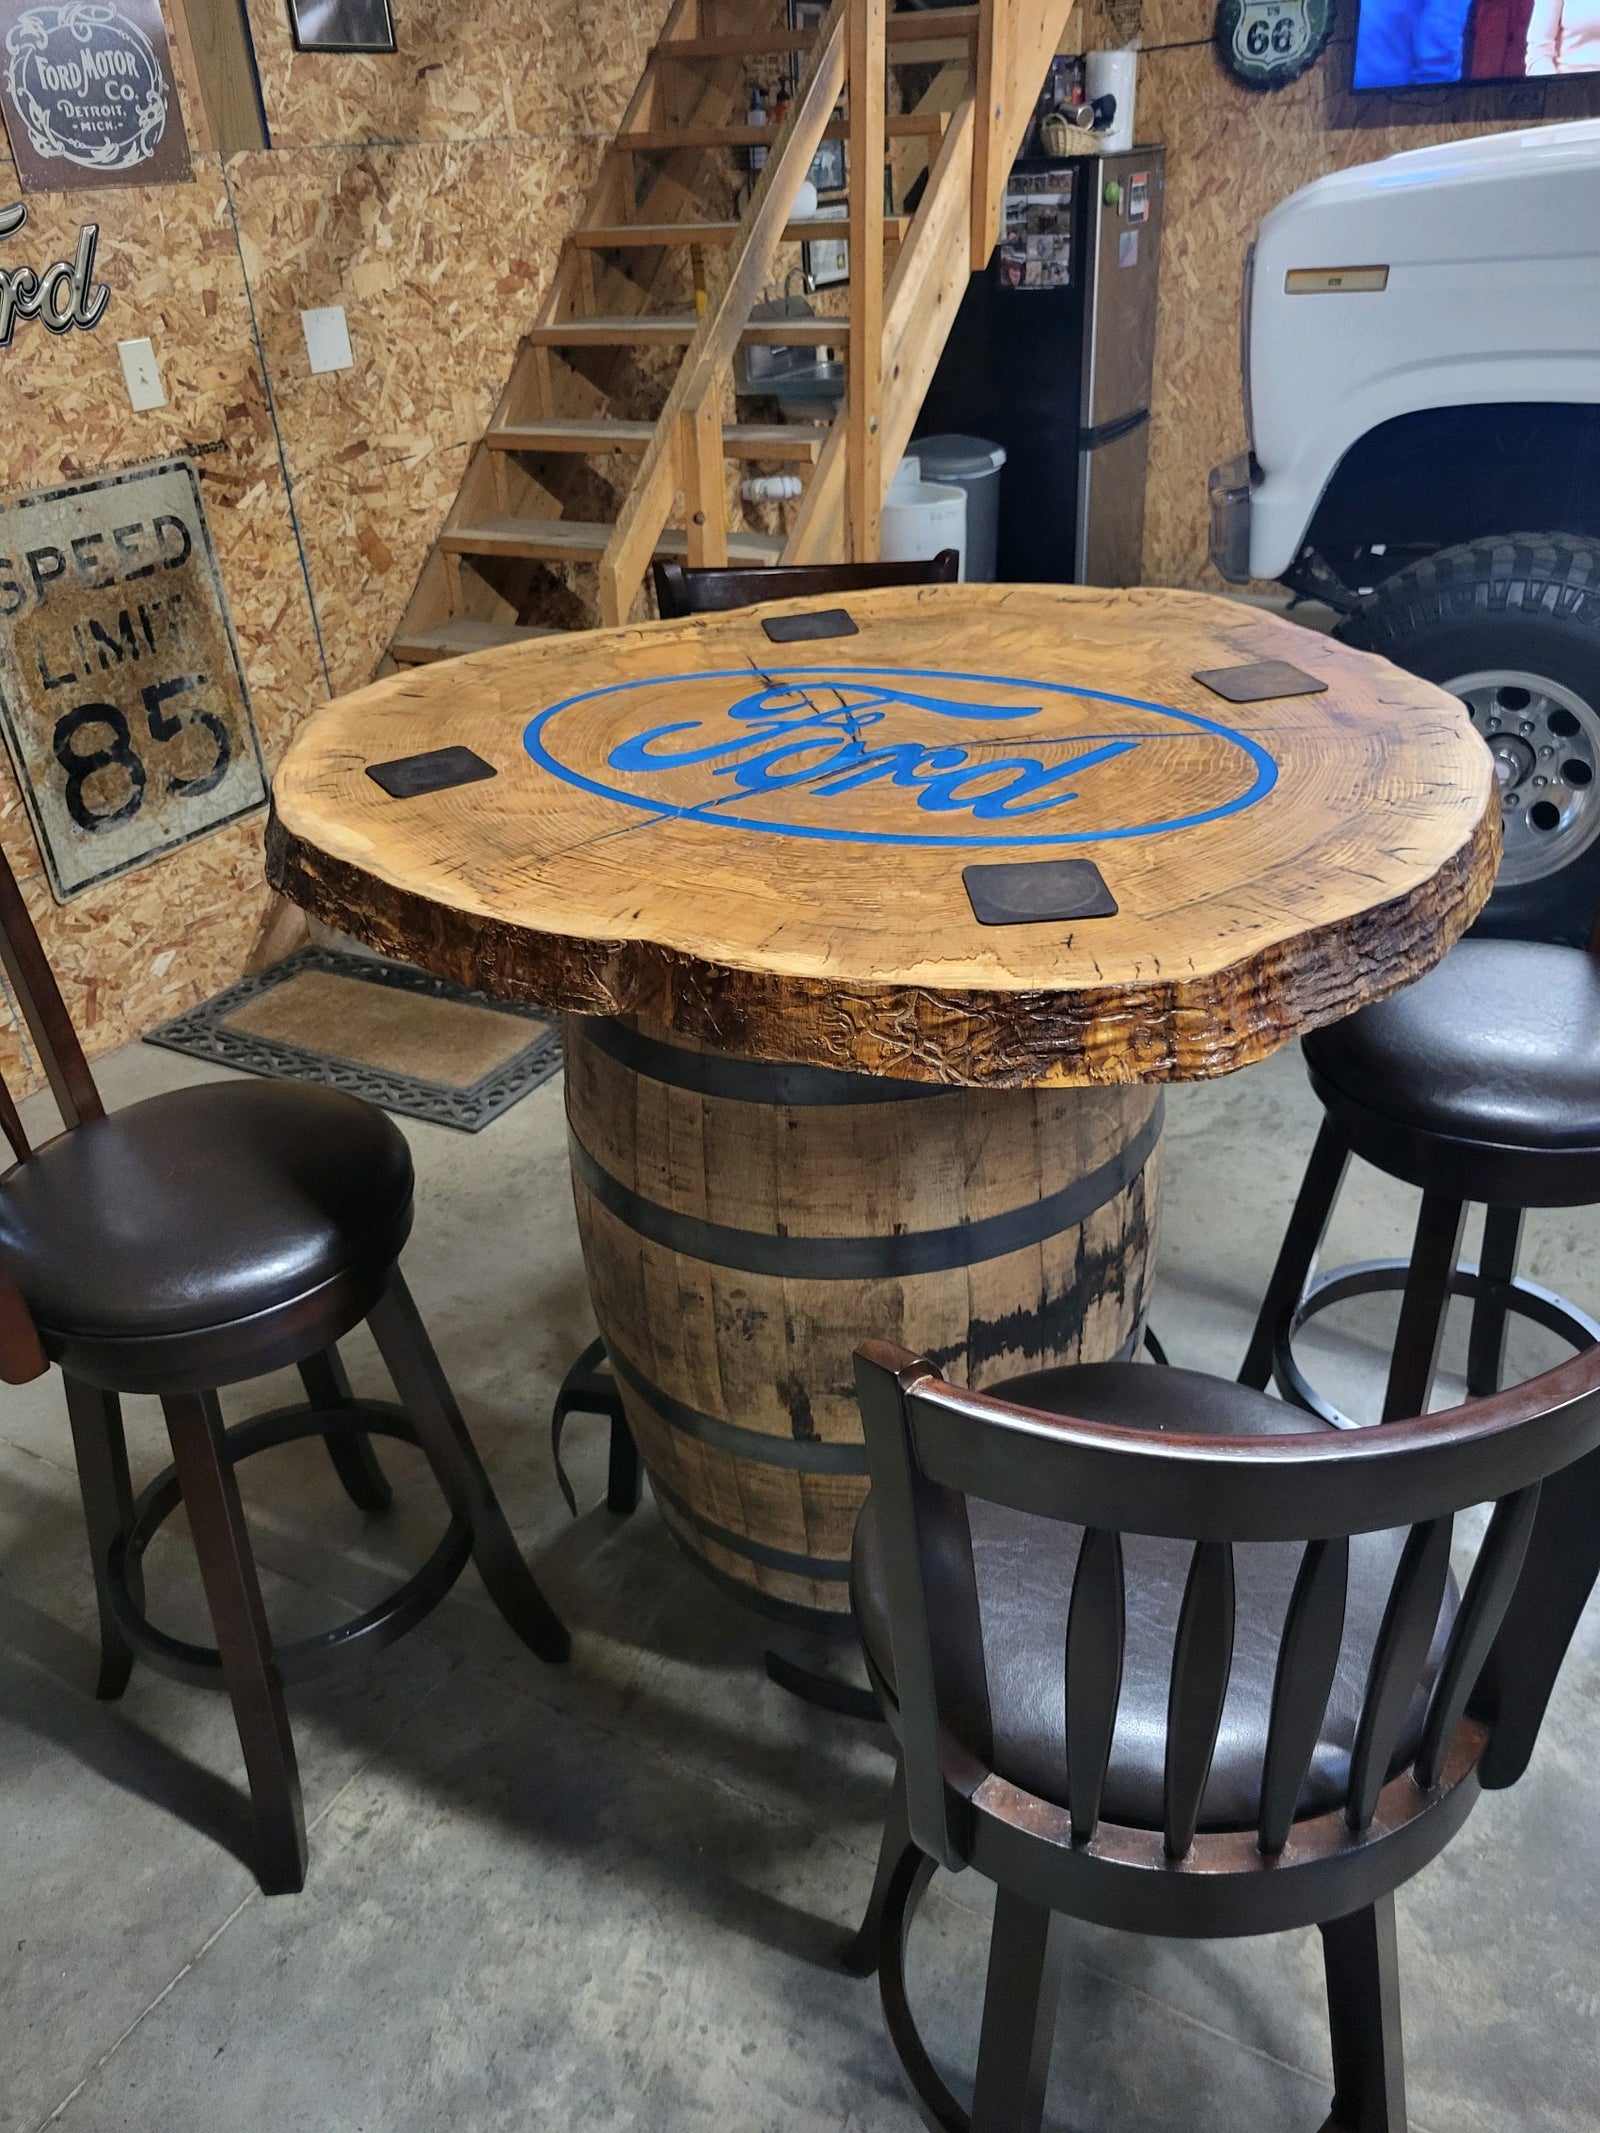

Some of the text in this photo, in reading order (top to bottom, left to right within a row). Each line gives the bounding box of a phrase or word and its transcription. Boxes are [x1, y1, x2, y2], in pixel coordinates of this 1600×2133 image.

[1246, 17, 1296, 55] 66
[1265, 6, 1281, 16] US
[77, 47, 140, 98] MOTOR
[0, 514, 192, 615] SPEED
[34, 594, 184, 690] LIMIT
[52, 675, 231, 834] 85
[607, 683, 1142, 819] Ford
